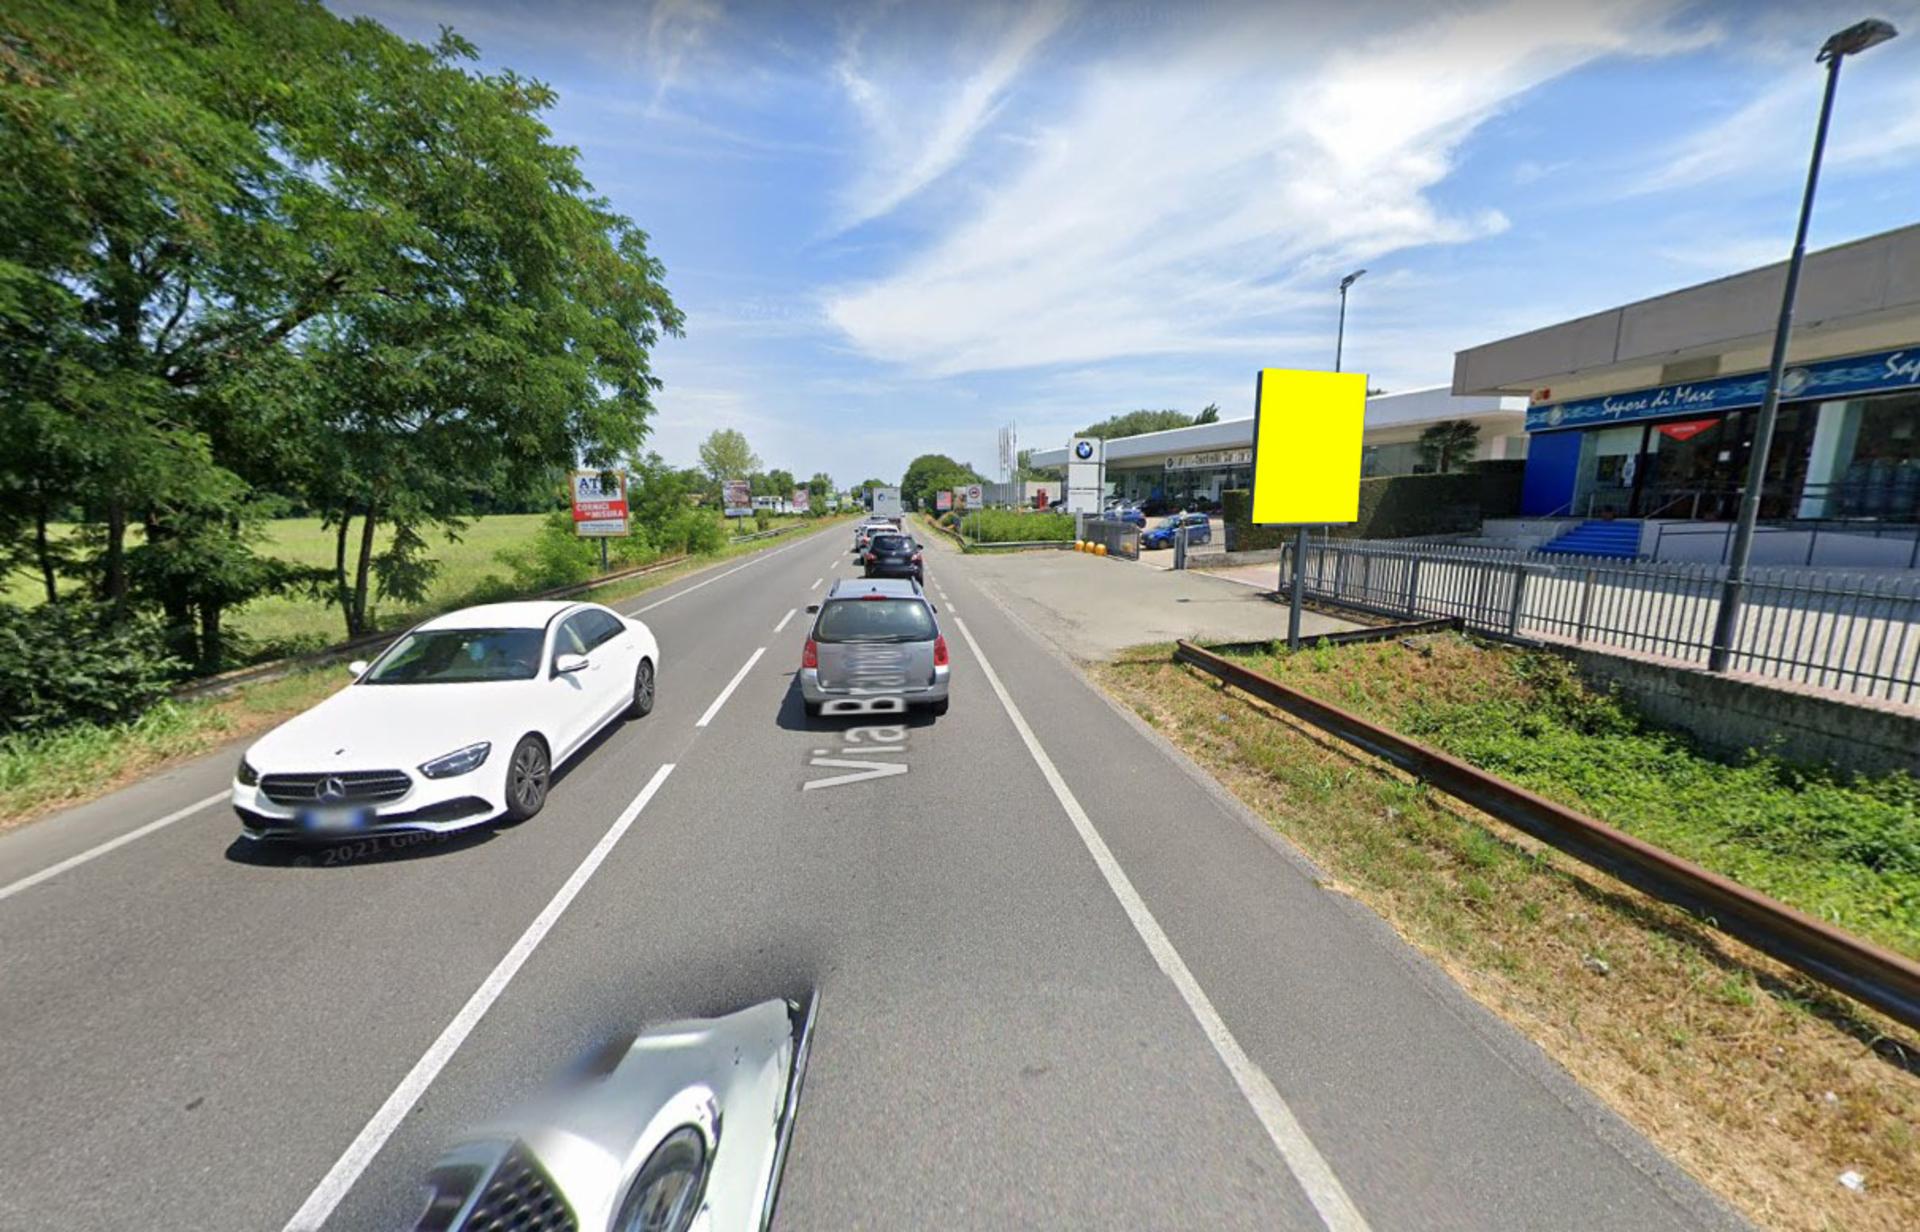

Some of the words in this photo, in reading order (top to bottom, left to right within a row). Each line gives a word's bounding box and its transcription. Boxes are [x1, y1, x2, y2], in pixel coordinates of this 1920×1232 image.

[1602, 397, 1648, 419] Sapore
[1651, 390, 1671, 408] di
[1672, 386, 1717, 406] Mare
